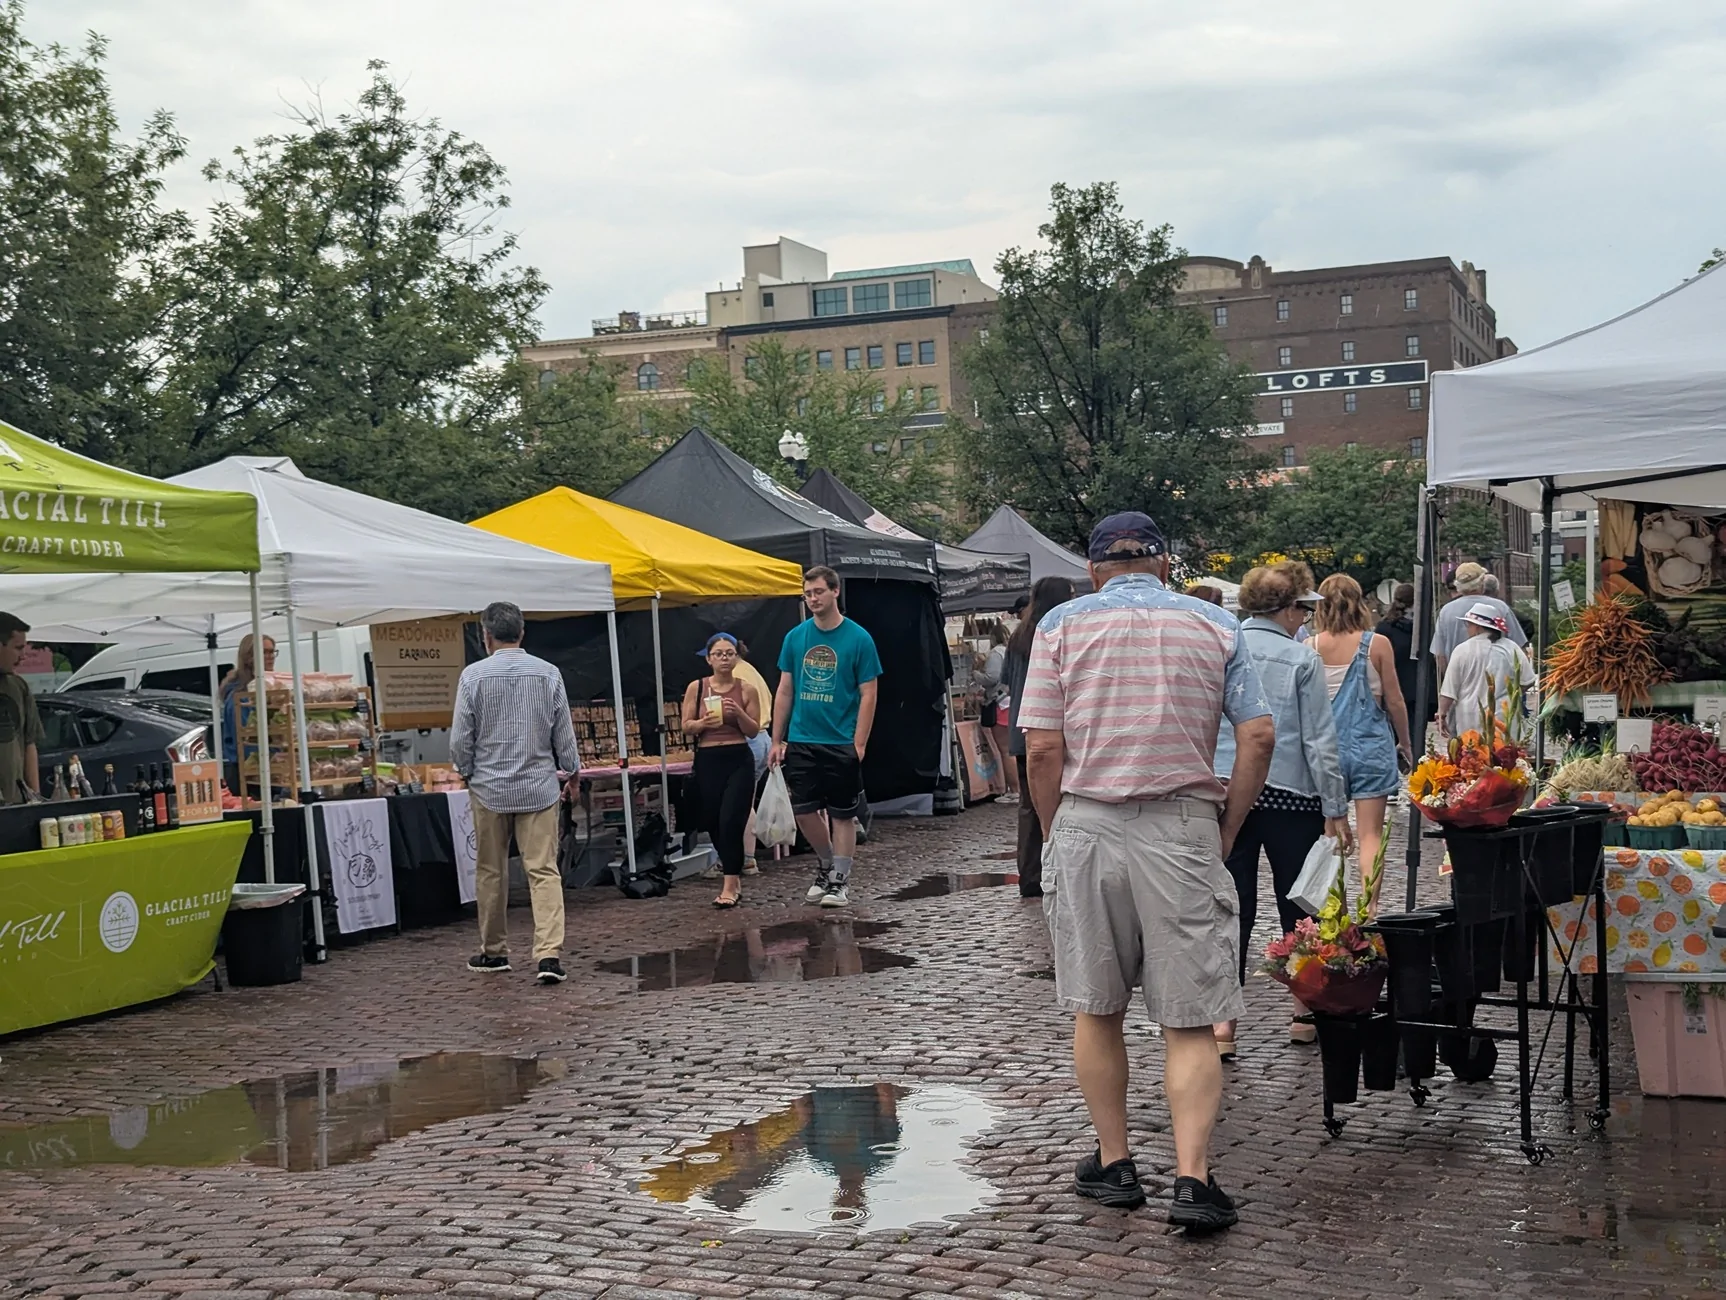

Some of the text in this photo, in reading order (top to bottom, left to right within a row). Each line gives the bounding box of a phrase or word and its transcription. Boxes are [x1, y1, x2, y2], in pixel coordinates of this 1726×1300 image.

[1267, 369, 1386, 391] LOFTS
[1254, 424, 1280, 435] EVATE
[101, 497, 166, 528] TILL
[2, 535, 125, 558] CRAFT CIDER
[399, 648, 441, 660] EARRINGS
[180, 809, 186, 817] 2
[145, 889, 229, 917] GLACIAL TILL
[11, 910, 66, 949] Till
[165, 910, 211, 927] CRAFT CIDER
